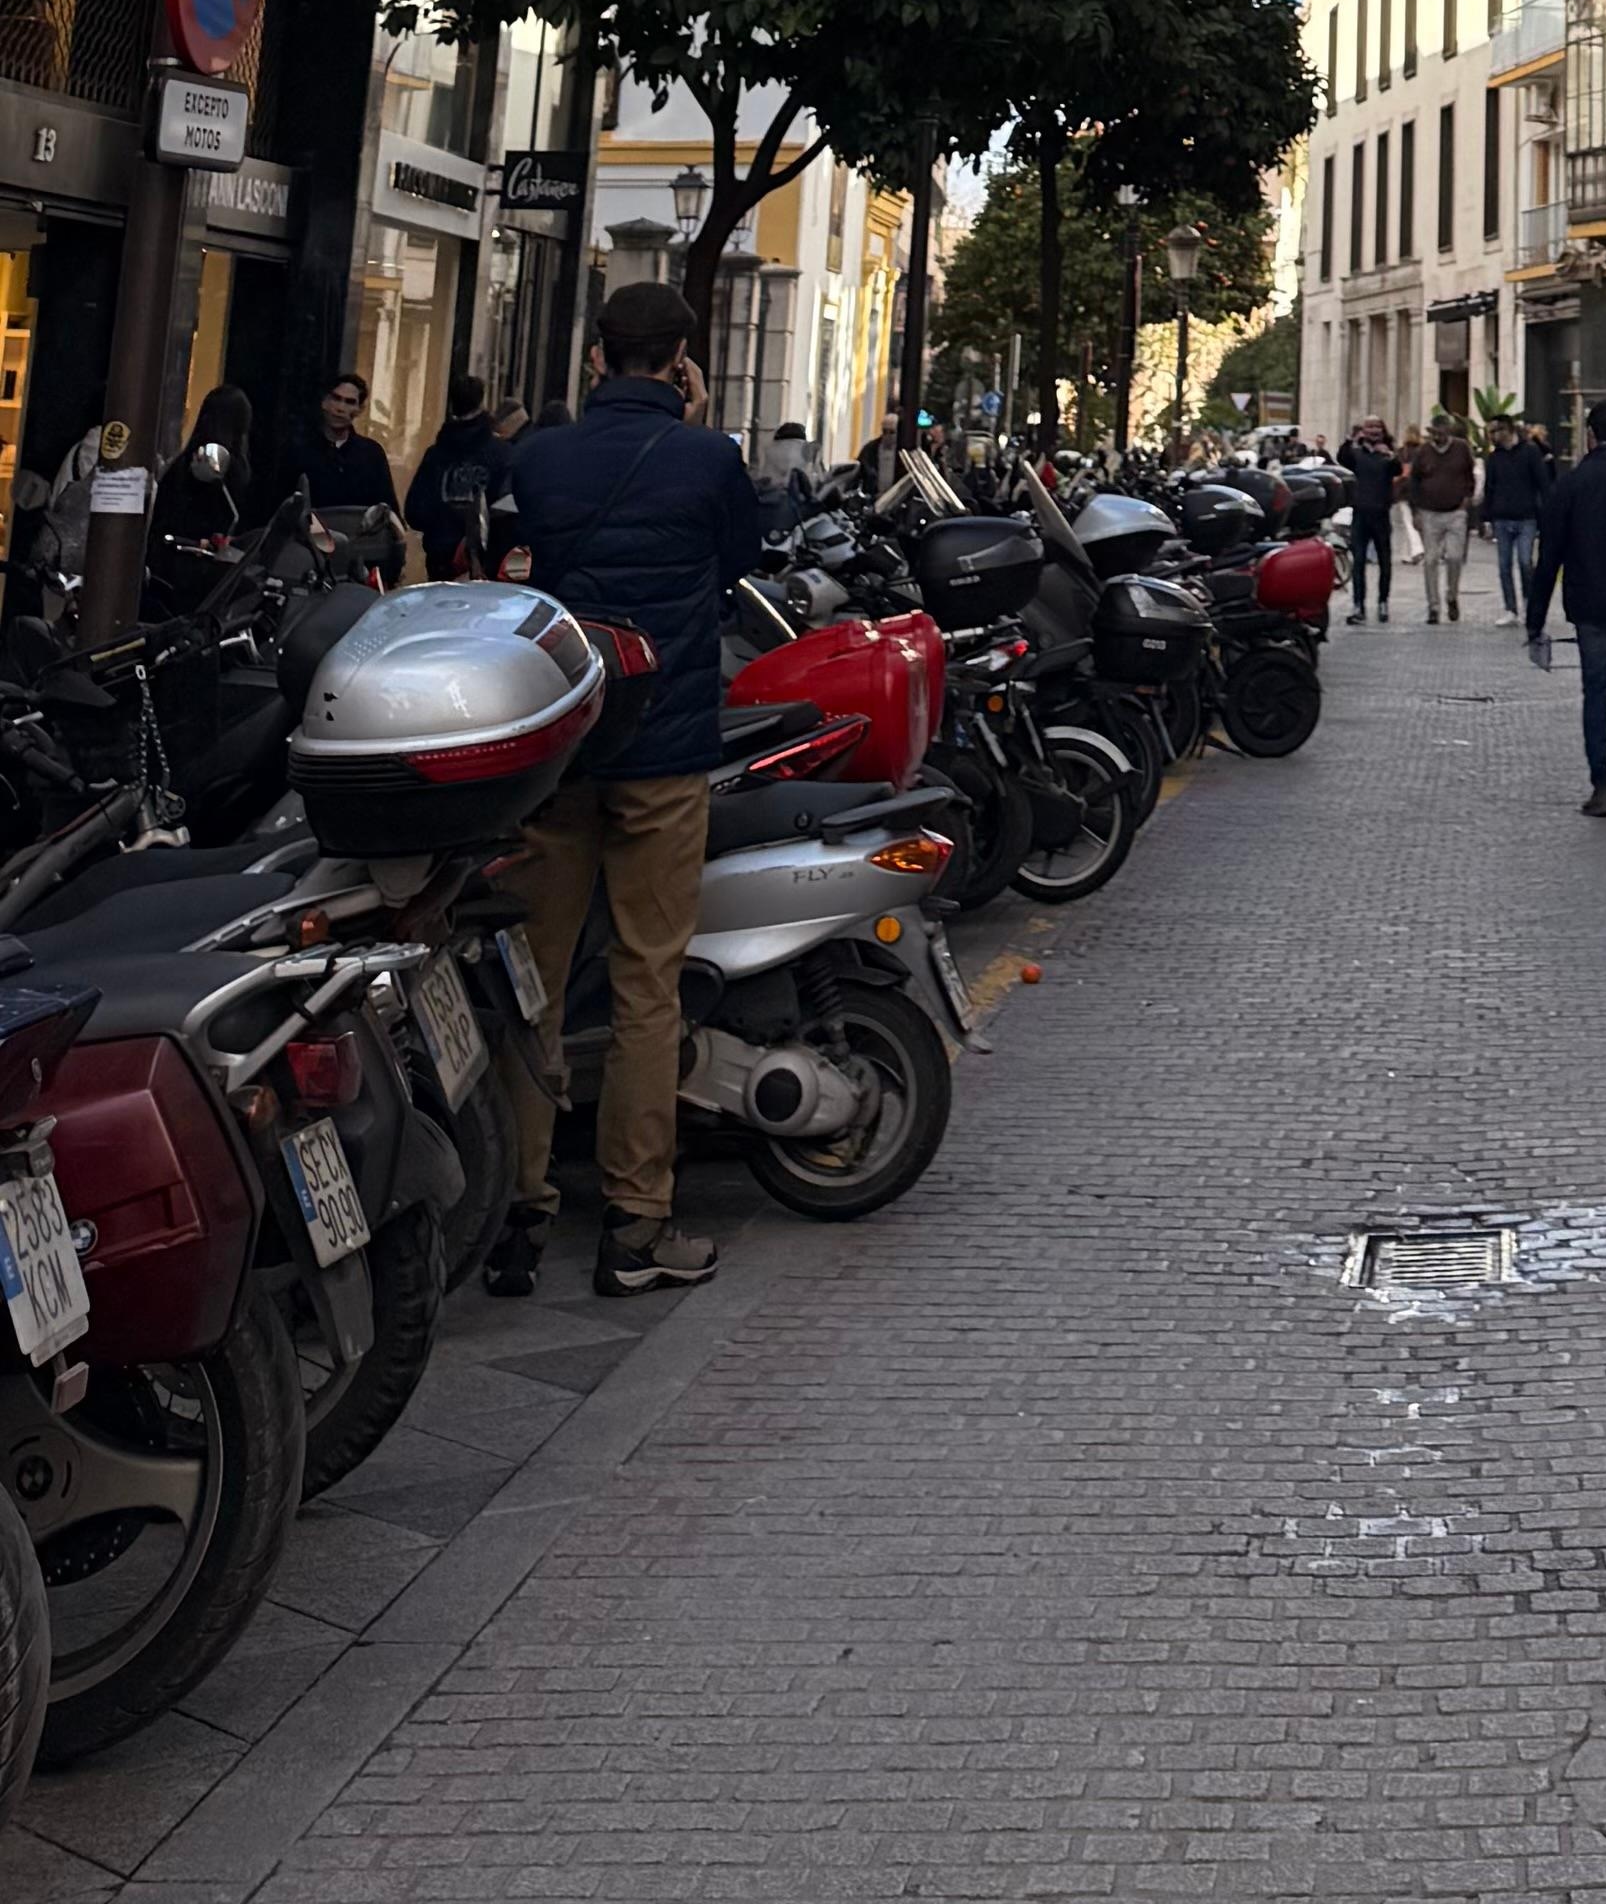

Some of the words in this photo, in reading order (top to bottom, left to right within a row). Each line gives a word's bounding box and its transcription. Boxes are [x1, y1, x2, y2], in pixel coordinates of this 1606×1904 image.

[184, 92, 229, 118] EXCEPTO
[33, 127, 57, 162] 13
[185, 125, 221, 150] MOTOS
[793, 865, 834, 883] FLY
[300, 1129, 348, 1191] SECX
[3, 1178, 62, 1259] 2583
[318, 1185, 364, 1248] 9090
[23, 1249, 72, 1329] KCM
